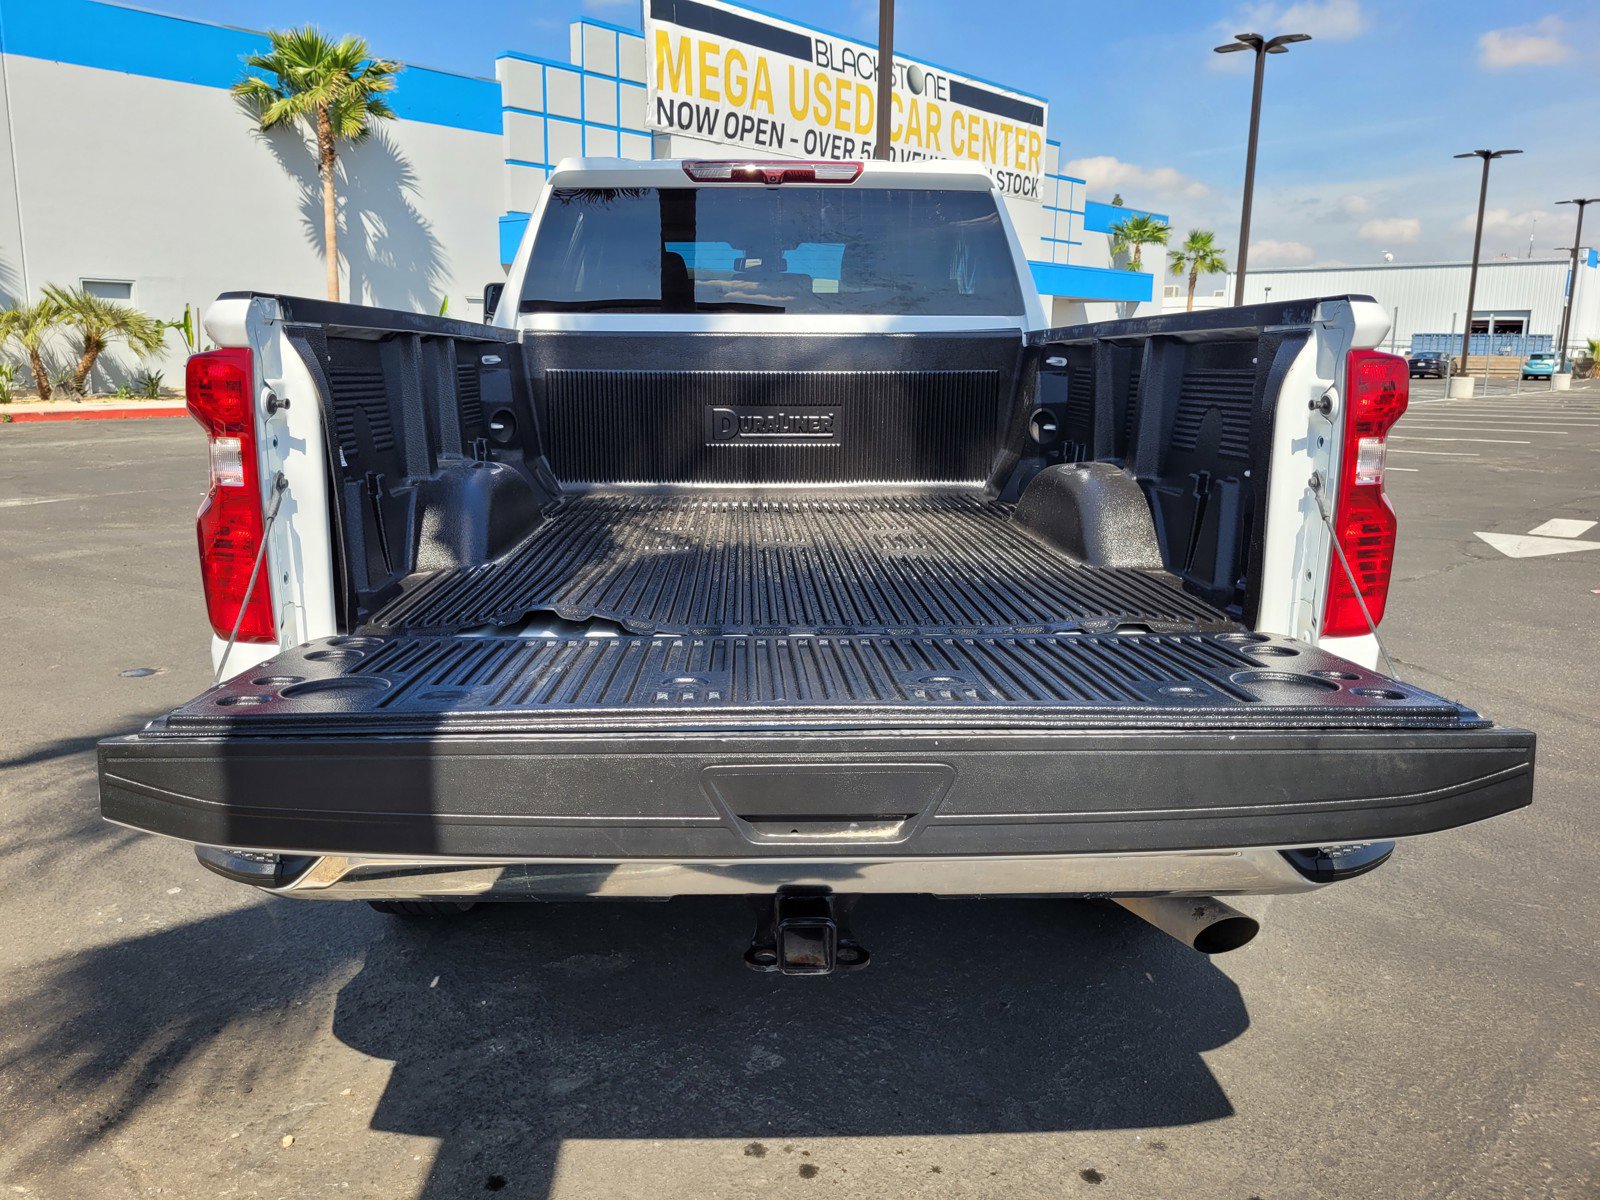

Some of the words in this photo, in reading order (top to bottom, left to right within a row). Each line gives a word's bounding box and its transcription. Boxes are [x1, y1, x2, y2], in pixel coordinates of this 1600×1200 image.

[655, 29, 774, 115] MEGA
[788, 64, 874, 135] USED
[890, 92, 942, 151] CAR
[950, 110, 1042, 174] CENTER
[656, 97, 720, 136] NOW
[724, 111, 785, 149] OPEN
[803, 129, 856, 160] OVER
[996, 172, 1039, 198] STOCK
